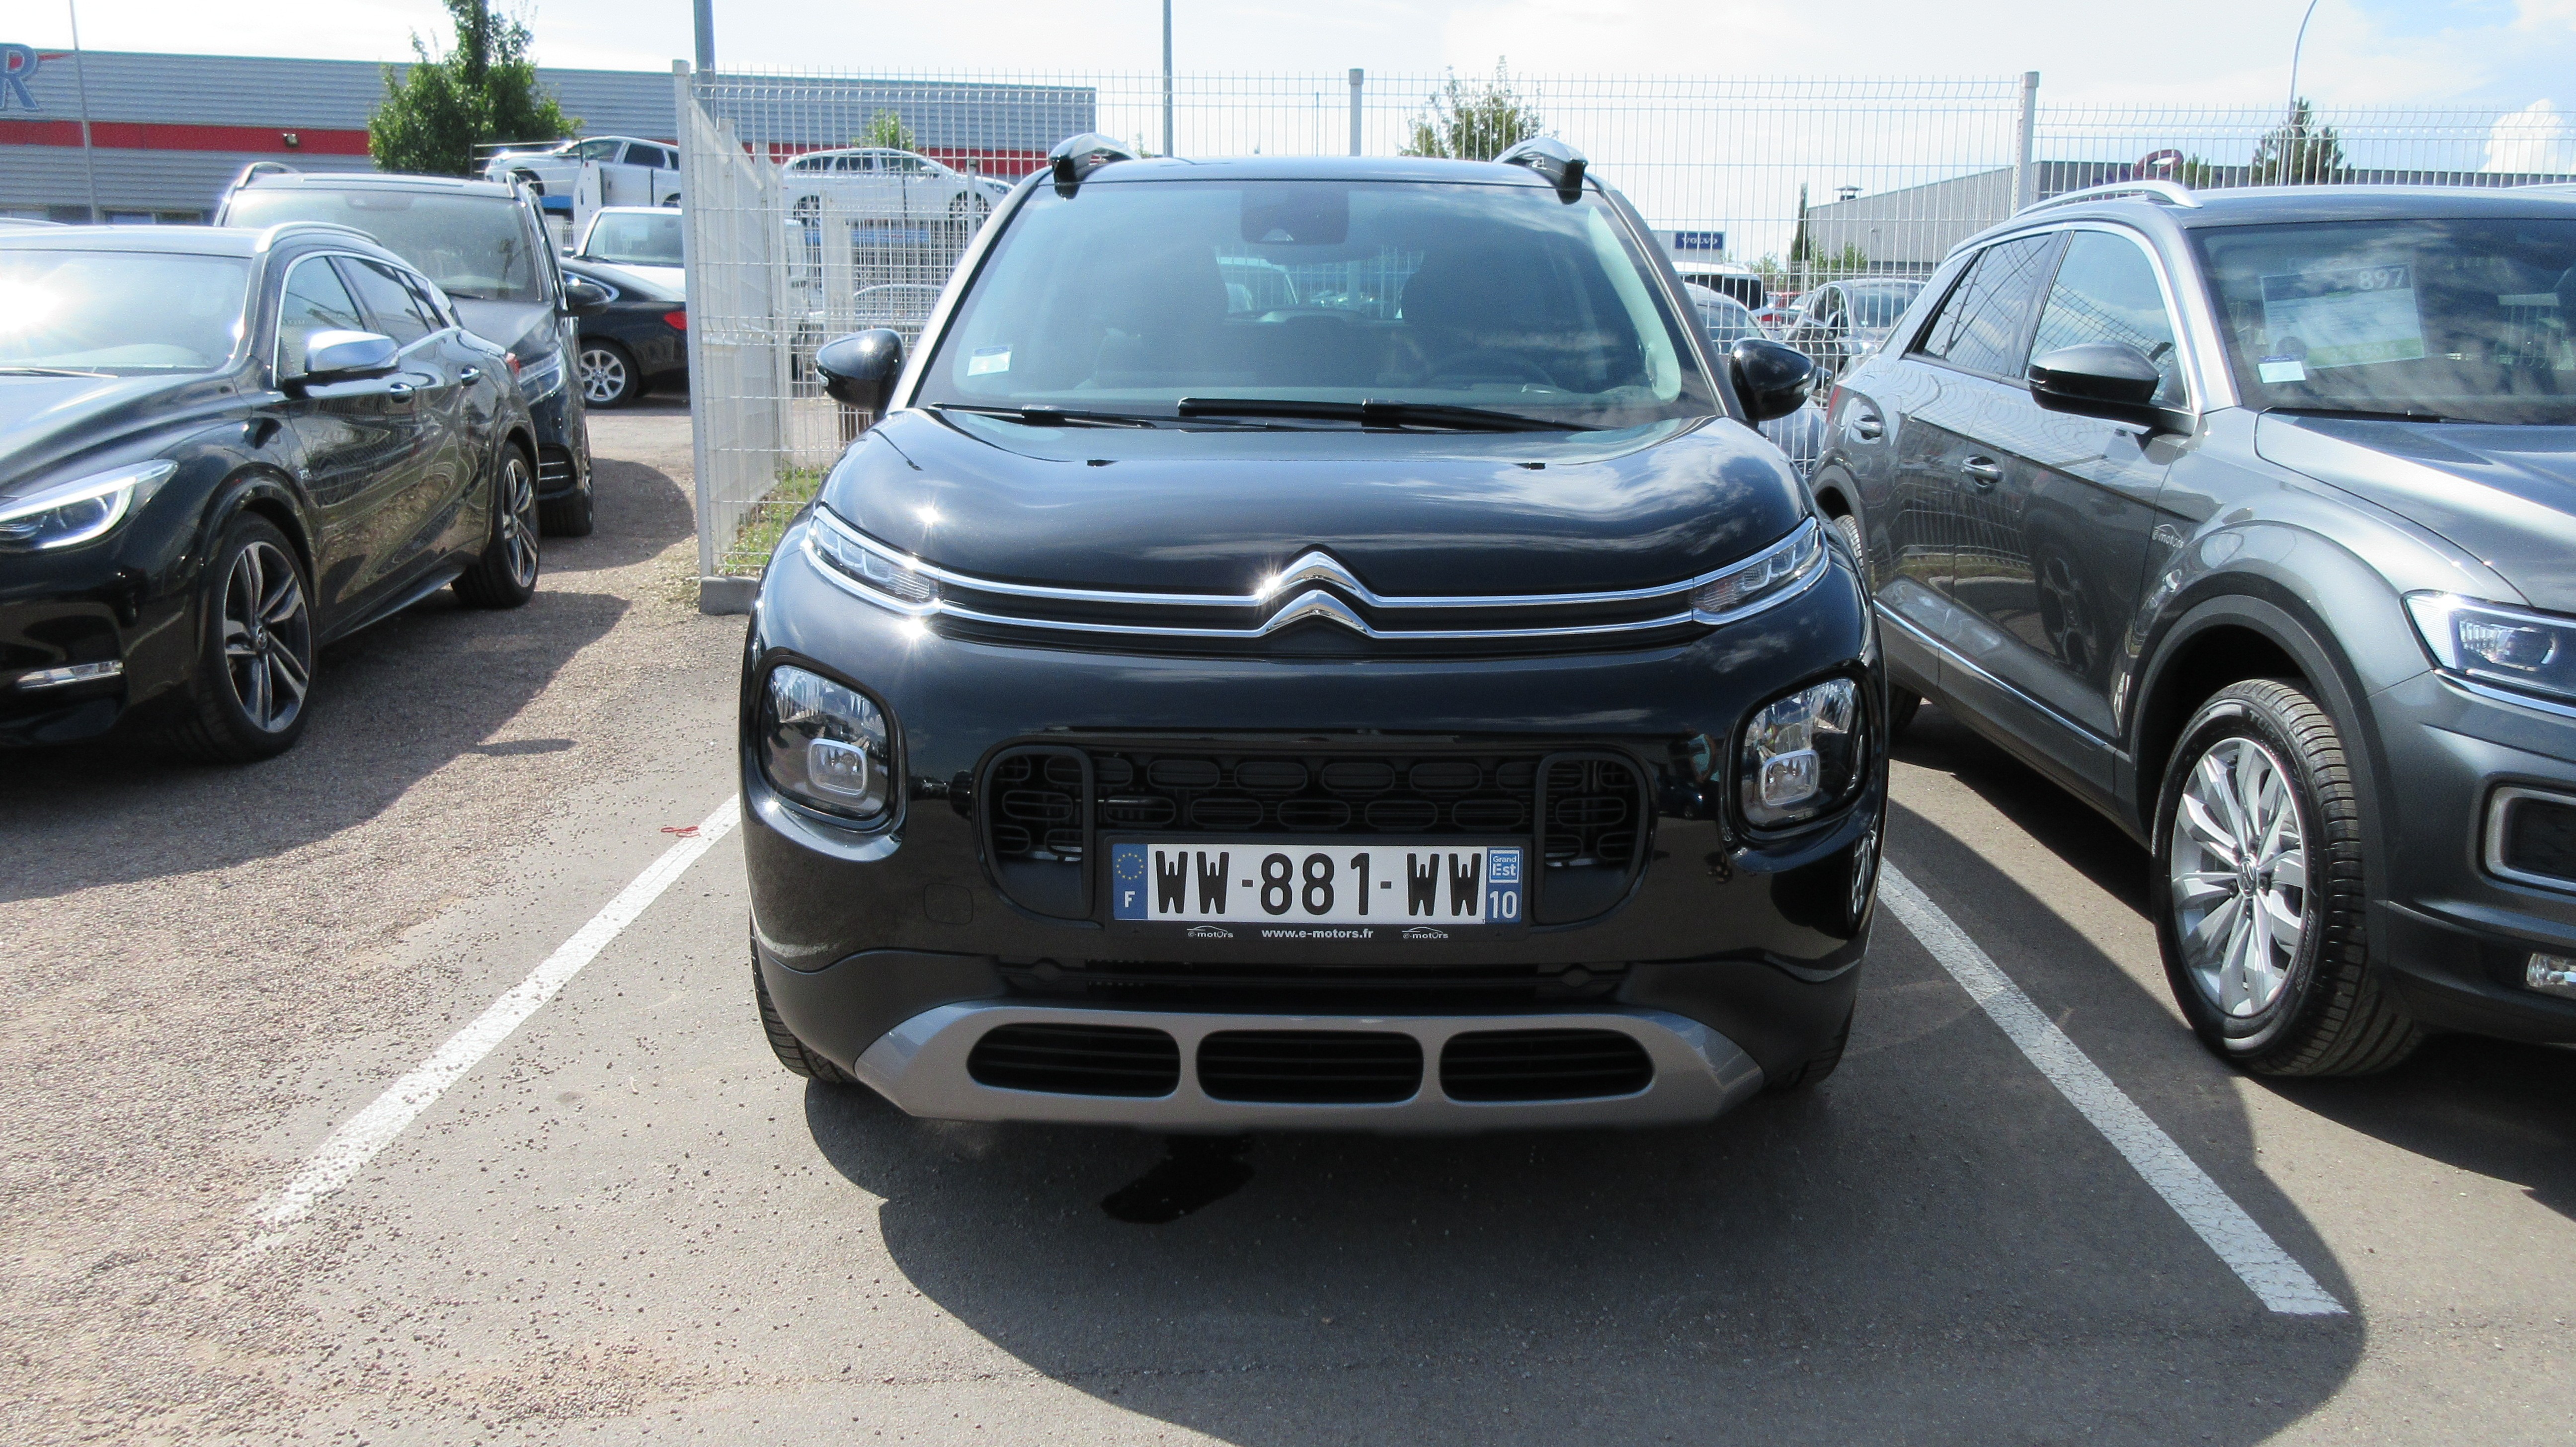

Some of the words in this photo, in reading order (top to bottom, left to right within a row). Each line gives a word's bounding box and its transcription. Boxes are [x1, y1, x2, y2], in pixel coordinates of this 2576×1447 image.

[2358, 268, 2405, 289] 897
[1492, 863, 1516, 876] Est
[1124, 891, 1135, 908] F
[1490, 890, 1517, 919] 10
[1261, 928, 1374, 939] www.e-motors.fr
